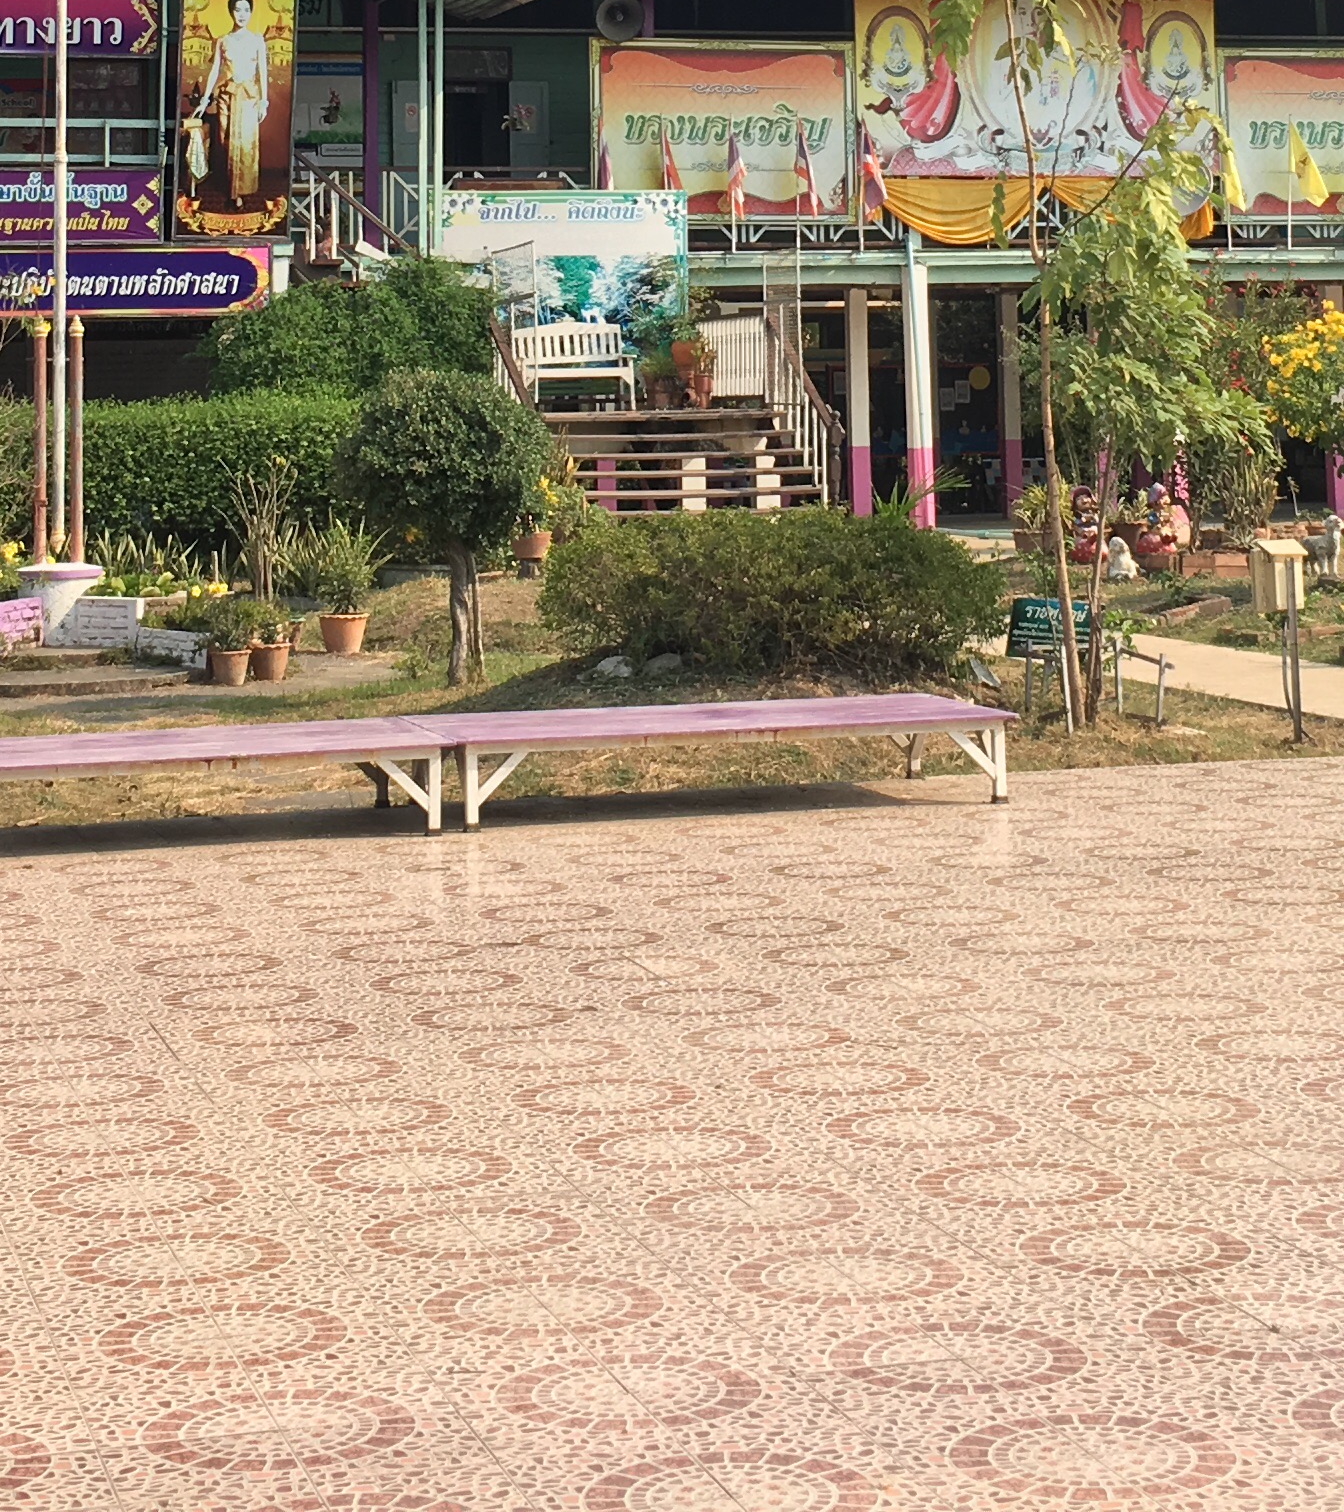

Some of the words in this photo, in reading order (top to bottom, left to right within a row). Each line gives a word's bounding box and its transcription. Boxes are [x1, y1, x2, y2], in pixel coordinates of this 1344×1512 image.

[623, 102, 832, 154] ทรงพระเจริญ
